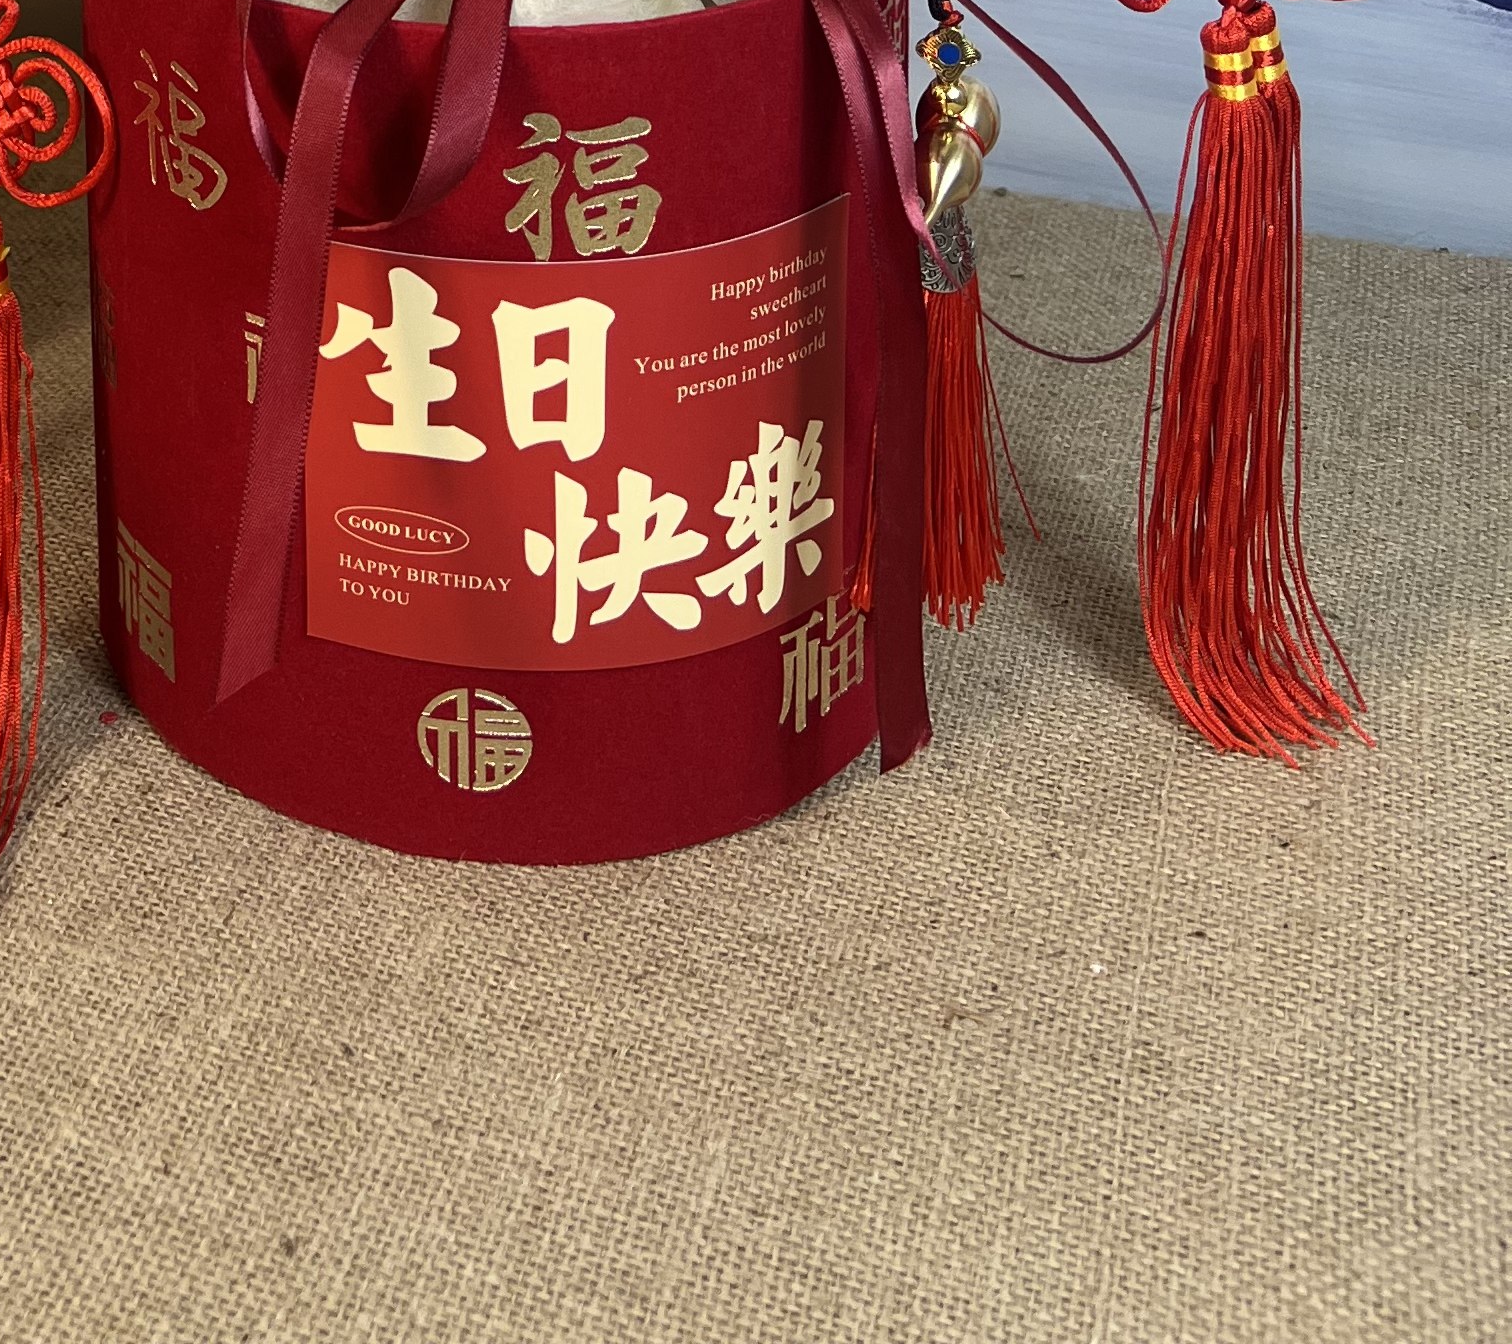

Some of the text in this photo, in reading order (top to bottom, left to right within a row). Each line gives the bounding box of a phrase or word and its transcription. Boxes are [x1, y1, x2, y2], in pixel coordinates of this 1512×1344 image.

[503, 112, 662, 262] 福
[710, 246, 828, 301] Happy birthday
[749, 275, 828, 321] sweetheart
[318, 267, 617, 465] 生日
[634, 306, 827, 375] You are the most lovely
[676, 331, 827, 403] person in the world
[348, 515, 456, 546] GOOD LUCY
[523, 419, 836, 644] 快樂
[339, 552, 512, 593] HAPPY BIRTHDAY
[340, 577, 410, 606] TO YOU
[418, 687, 534, 792] 福
